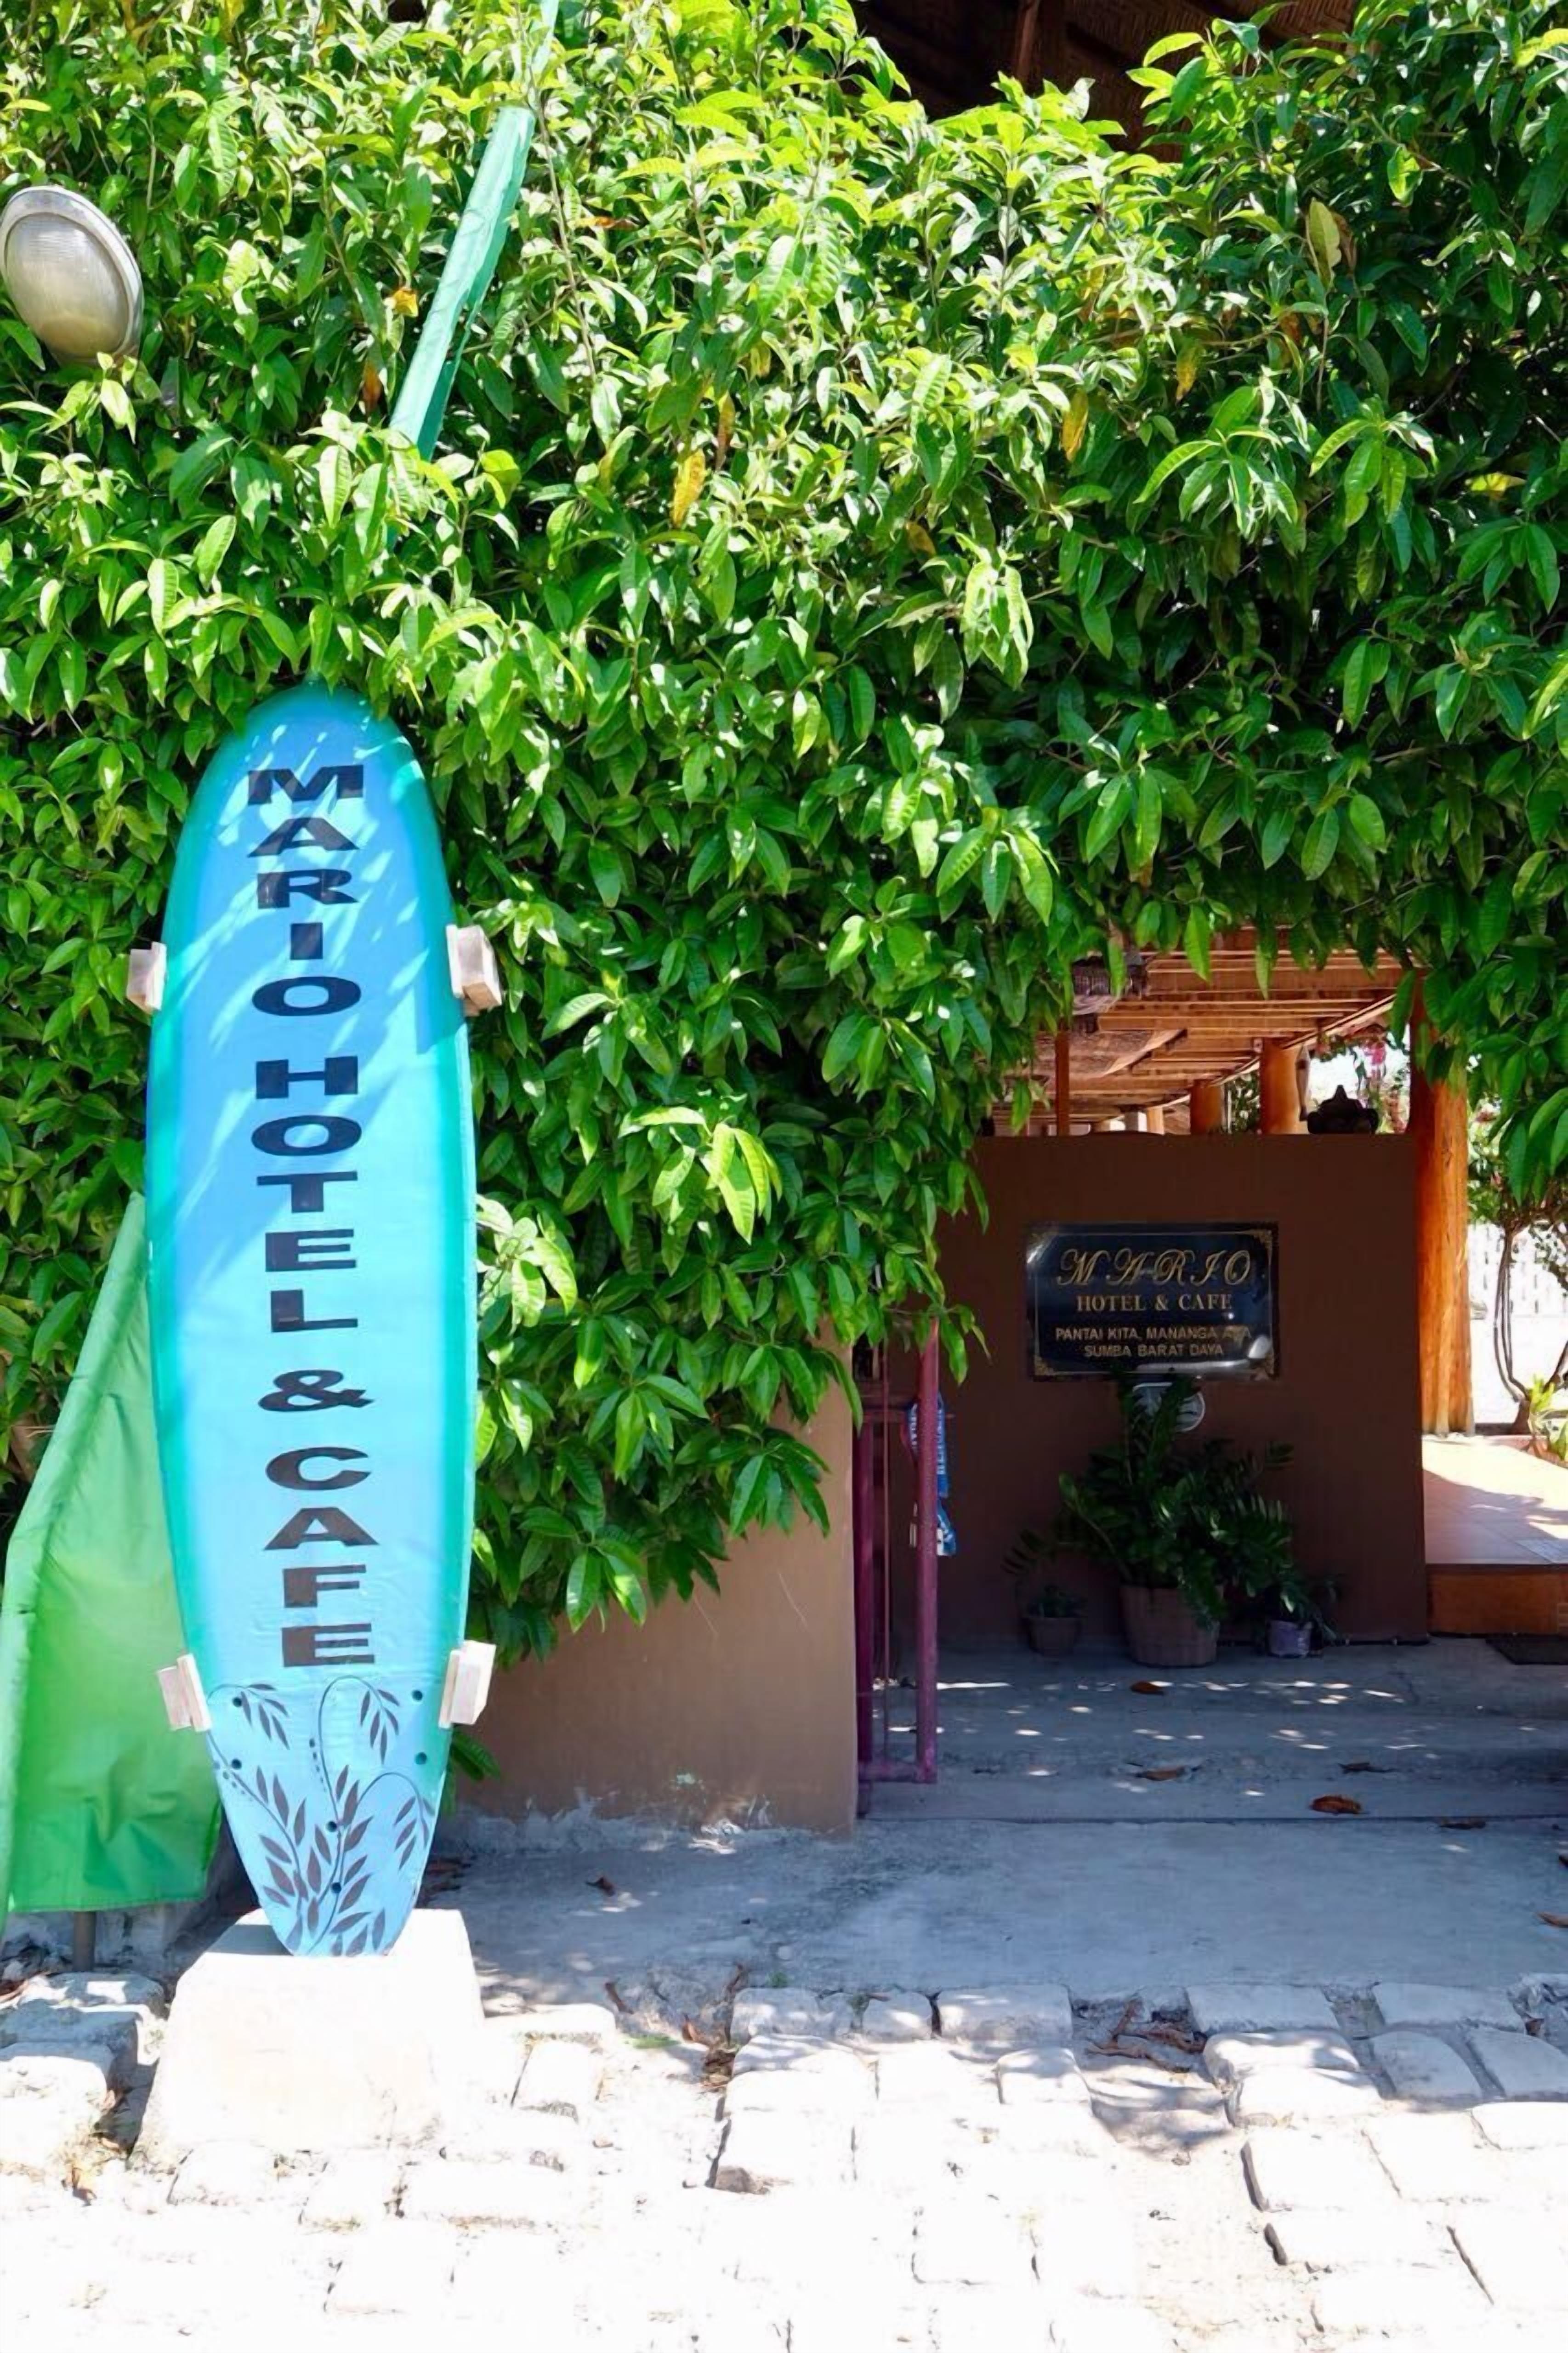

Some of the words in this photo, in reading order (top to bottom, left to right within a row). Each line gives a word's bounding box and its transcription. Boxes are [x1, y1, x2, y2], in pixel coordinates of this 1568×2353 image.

[247, 765, 364, 1017] MARIO
[251, 1056, 358, 1333] HOTEL
[1057, 1248, 1251, 1286] MARIO
[1077, 1295, 1146, 1312] HOTEL
[1154, 1295, 1169, 1311] &
[1179, 1294, 1233, 1310] CAFE
[1056, 1327, 1102, 1341] PANTAI
[1146, 1326, 1218, 1340] MANANGA
[1084, 1344, 1131, 1357] SUMBA
[1138, 1344, 1184, 1357] BARAT
[1190, 1344, 1223, 1356] DAYA
[258, 1370, 374, 1412] &
[263, 1446, 380, 1667] CAFE
